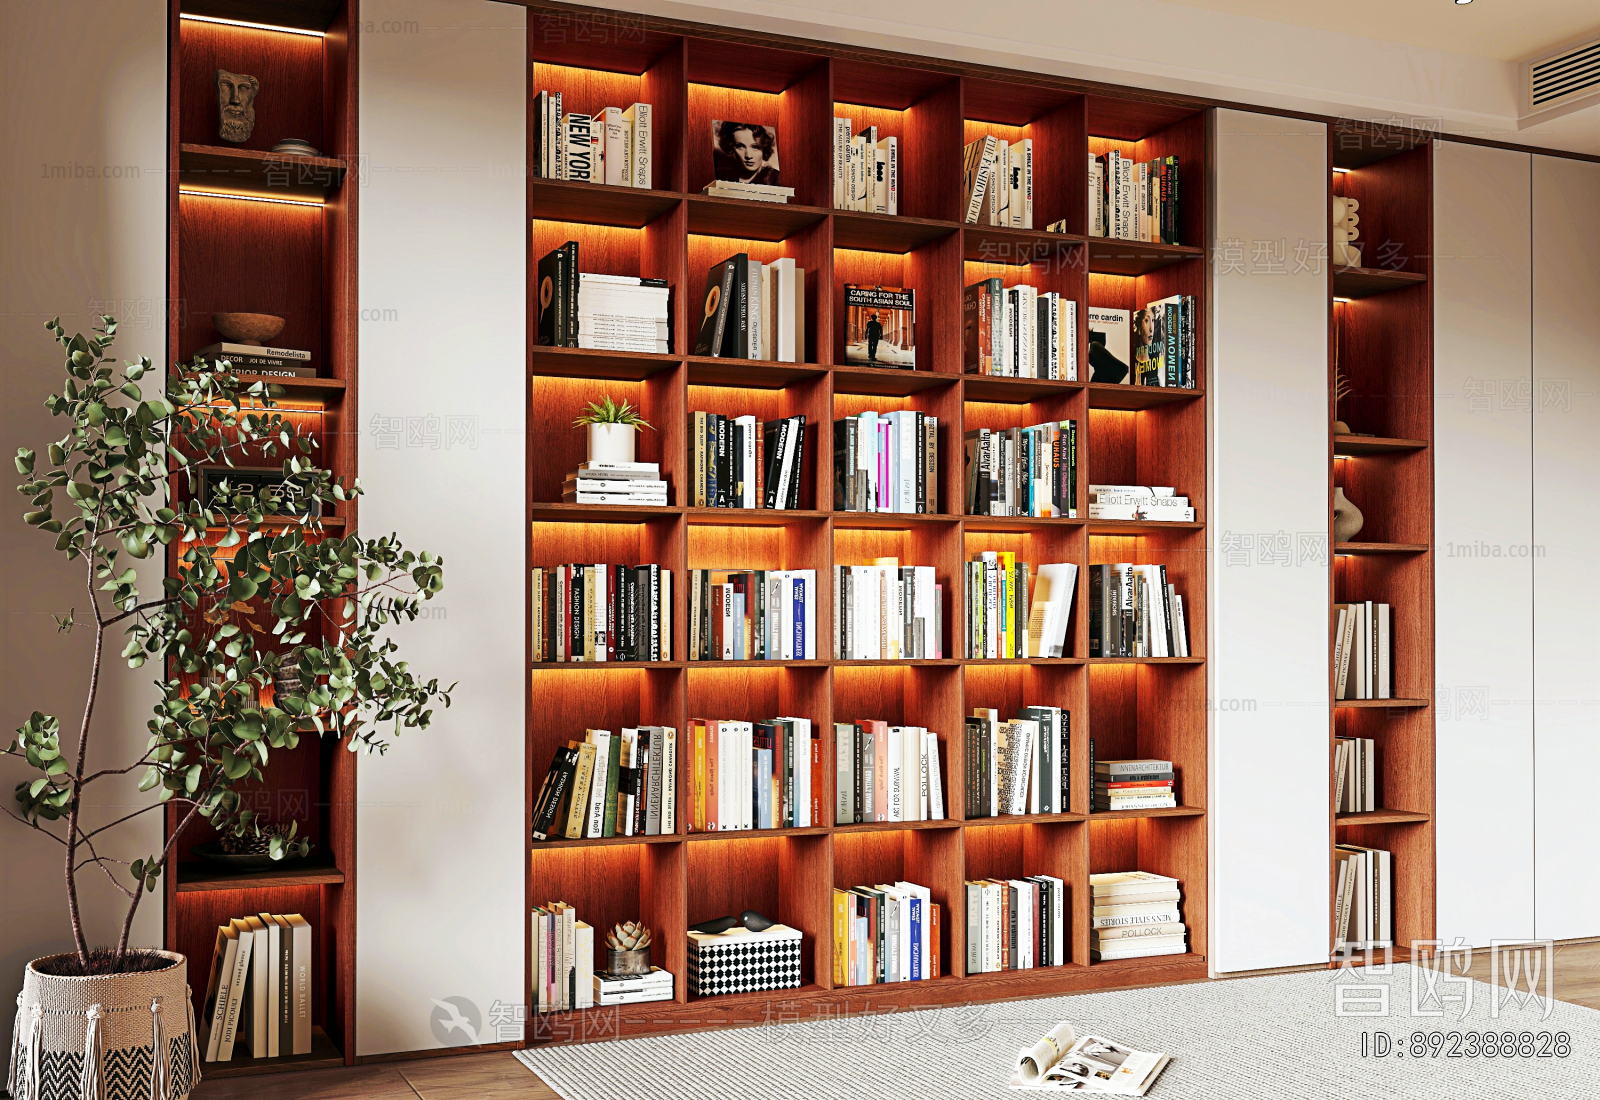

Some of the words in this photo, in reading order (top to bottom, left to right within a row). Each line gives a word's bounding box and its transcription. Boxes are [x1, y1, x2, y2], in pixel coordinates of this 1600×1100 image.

[638, 105, 648, 128] Elliott
[569, 114, 591, 148] NEW
[638, 130, 648, 155] Erwitt
[984, 138, 998, 158] THE
[638, 156, 648, 186] Snaps
[974, 158, 992, 199] FASHION
[850, 290, 877, 298] CARING
[1101, 314, 1123, 322] cardin
[221, 355, 243, 363] DECOR
[266, 349, 306, 358] Remodelista
[776, 424, 787, 460] MODERN
[928, 442, 935, 450] BY
[1062, 463, 1068, 472] No
[1100, 494, 1121, 504] Elliott
[1124, 495, 1148, 505] Erwitt
[1151, 496, 1177, 506] Snaps
[1120, 763, 1169, 772] INNENARCHITEKTUR
[1100, 917, 1129, 926] STORIES
[1130, 916, 1150, 924] STYLE
[1122, 928, 1163, 938] POLLOCK
[216, 984, 228, 1021] SCHIELE
[228, 997, 237, 1026] PICOULT
